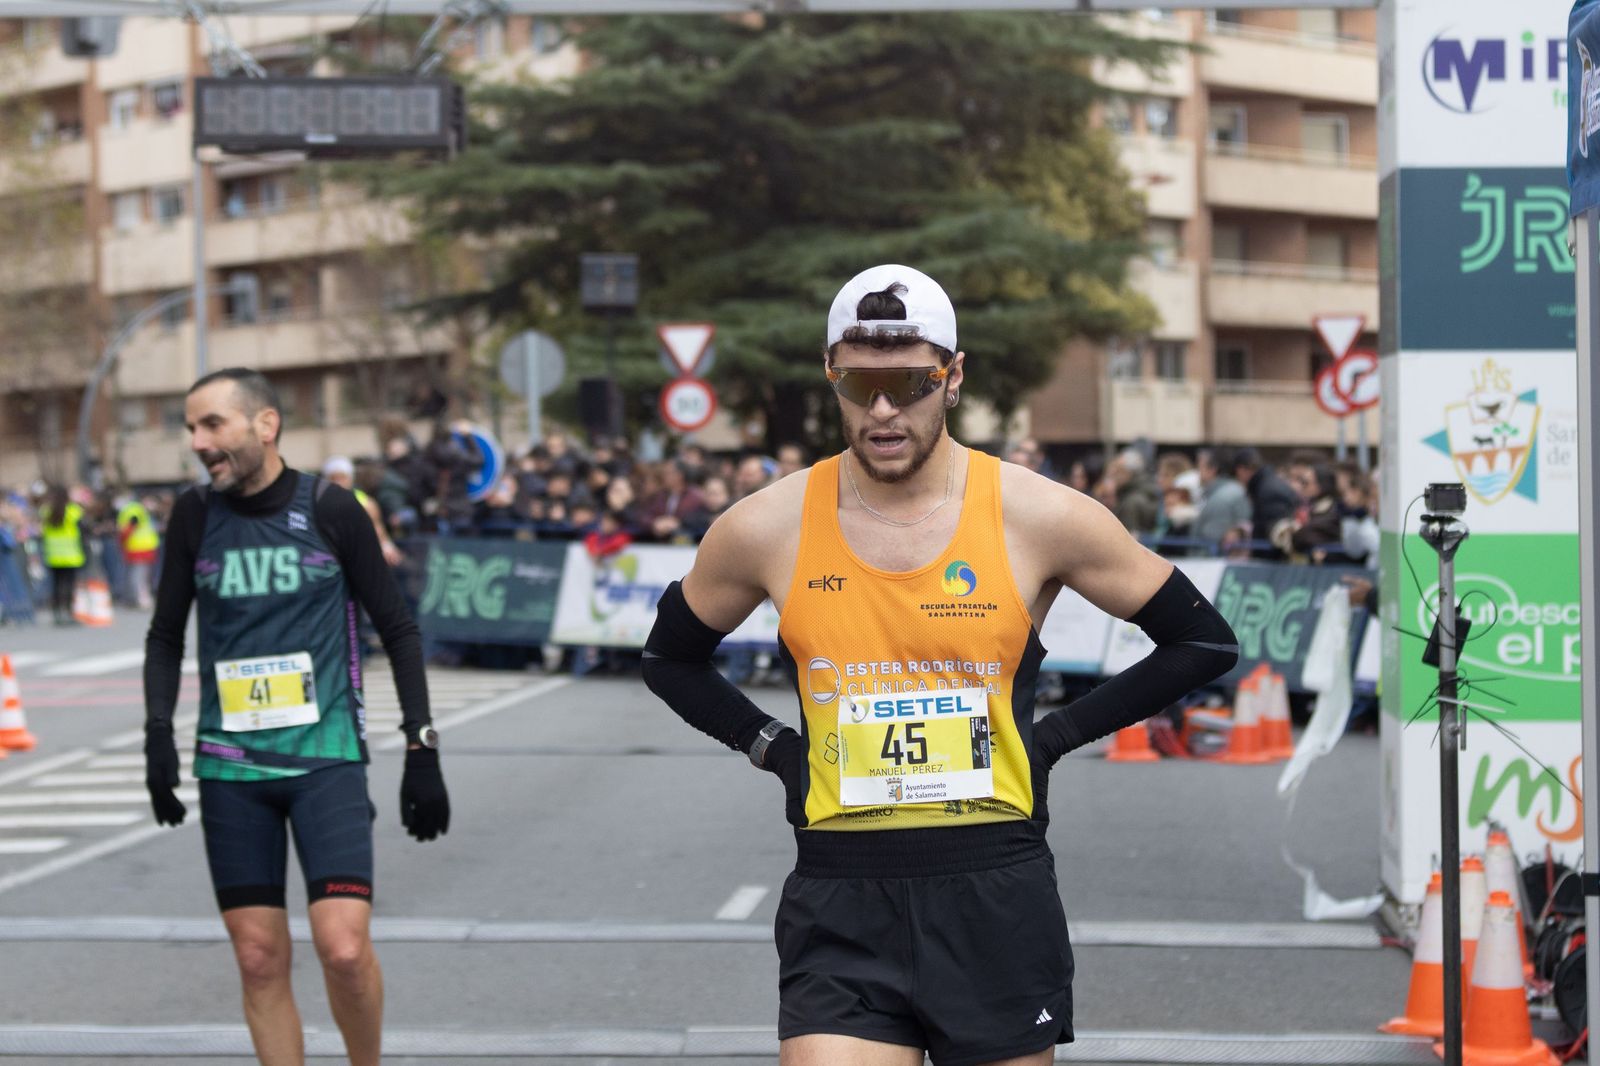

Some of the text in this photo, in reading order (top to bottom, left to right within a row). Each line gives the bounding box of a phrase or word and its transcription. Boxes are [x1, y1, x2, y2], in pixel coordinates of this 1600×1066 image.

[219, 547, 302, 597] AVS
[1497, 624, 1545, 665] el
[240, 661, 302, 676] SETEL
[845, 660, 903, 676] ESTER
[249, 678, 271, 705] 41
[847, 679, 929, 697] CLÍNICA
[874, 696, 973, 718] SETEL
[880, 722, 928, 766] 45
[869, 764, 944, 777] MANUEL PÉREZ
[905, 783, 947, 792] Ayuntamiento
[915, 790, 947, 799] Salamanca
